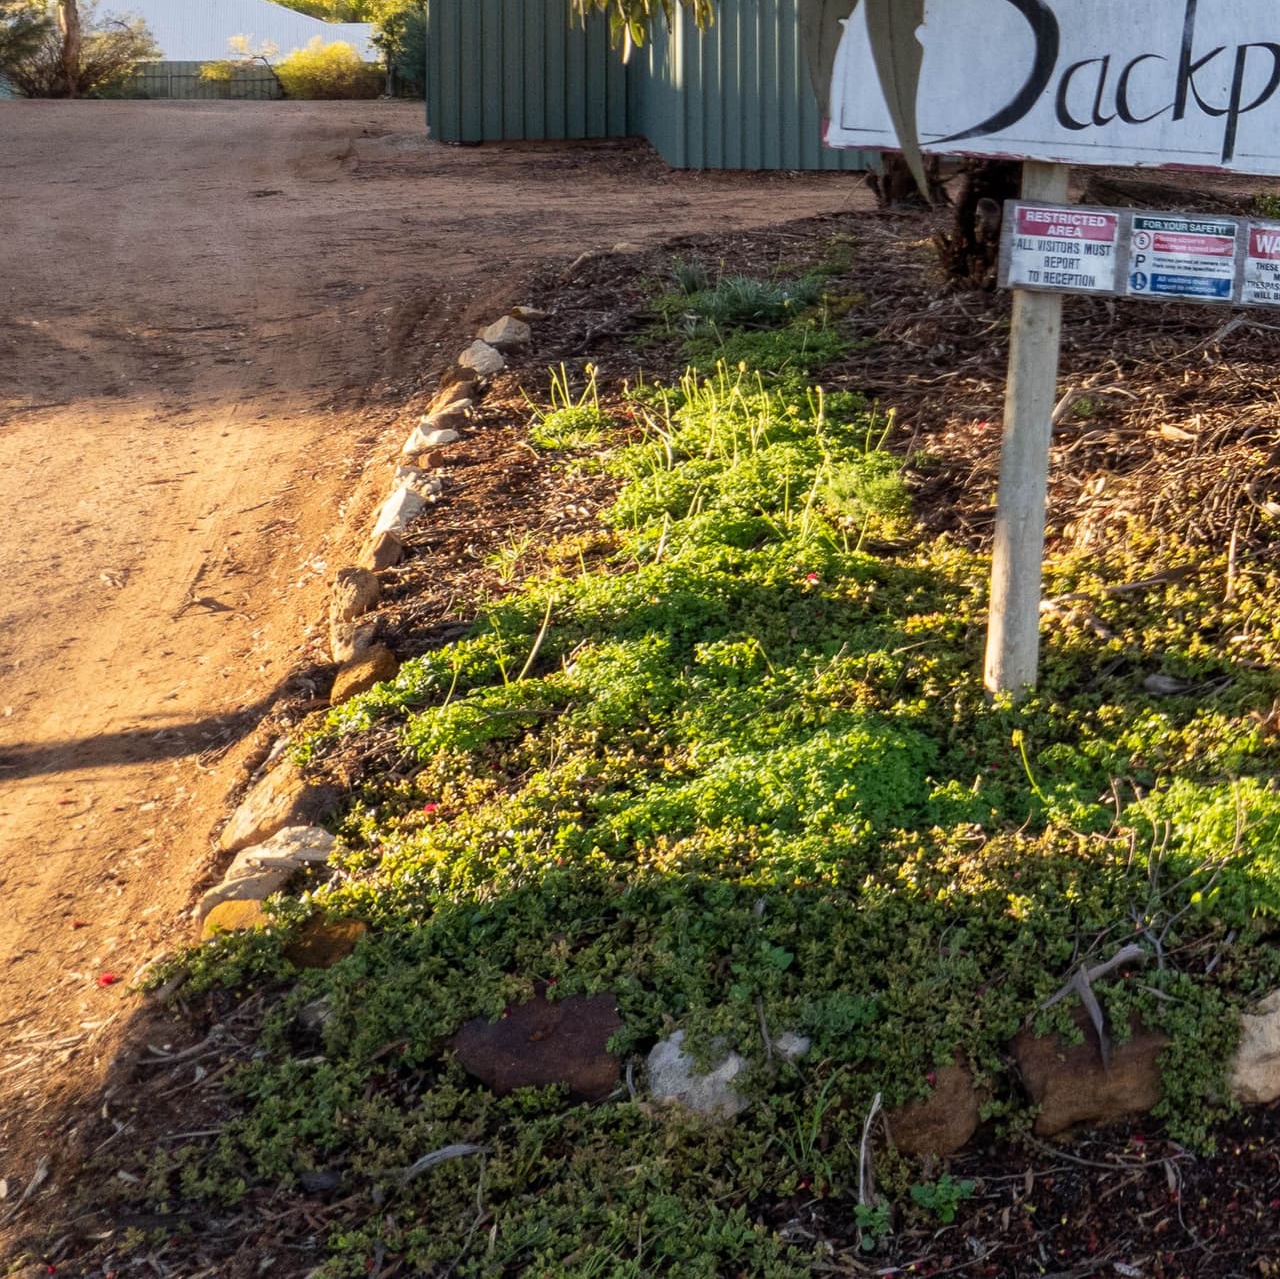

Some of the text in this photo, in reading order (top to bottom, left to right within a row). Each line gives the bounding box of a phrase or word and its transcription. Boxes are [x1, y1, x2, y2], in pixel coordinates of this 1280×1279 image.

[1025, 210, 1107, 227] RESTRICTED
[1047, 225, 1082, 237] AREA
[1143, 220, 1226, 234] FOR YOUR SAFETY!
[1016, 238, 1112, 256] ALL VISITORS MUST
[1044, 256, 1081, 270] REPORT
[1135, 254, 1146, 267] P
[1256, 262, 1279, 272] THESE
[1028, 270, 1096, 287] TO RECEPTION
[1253, 291, 1272, 300] WILL
